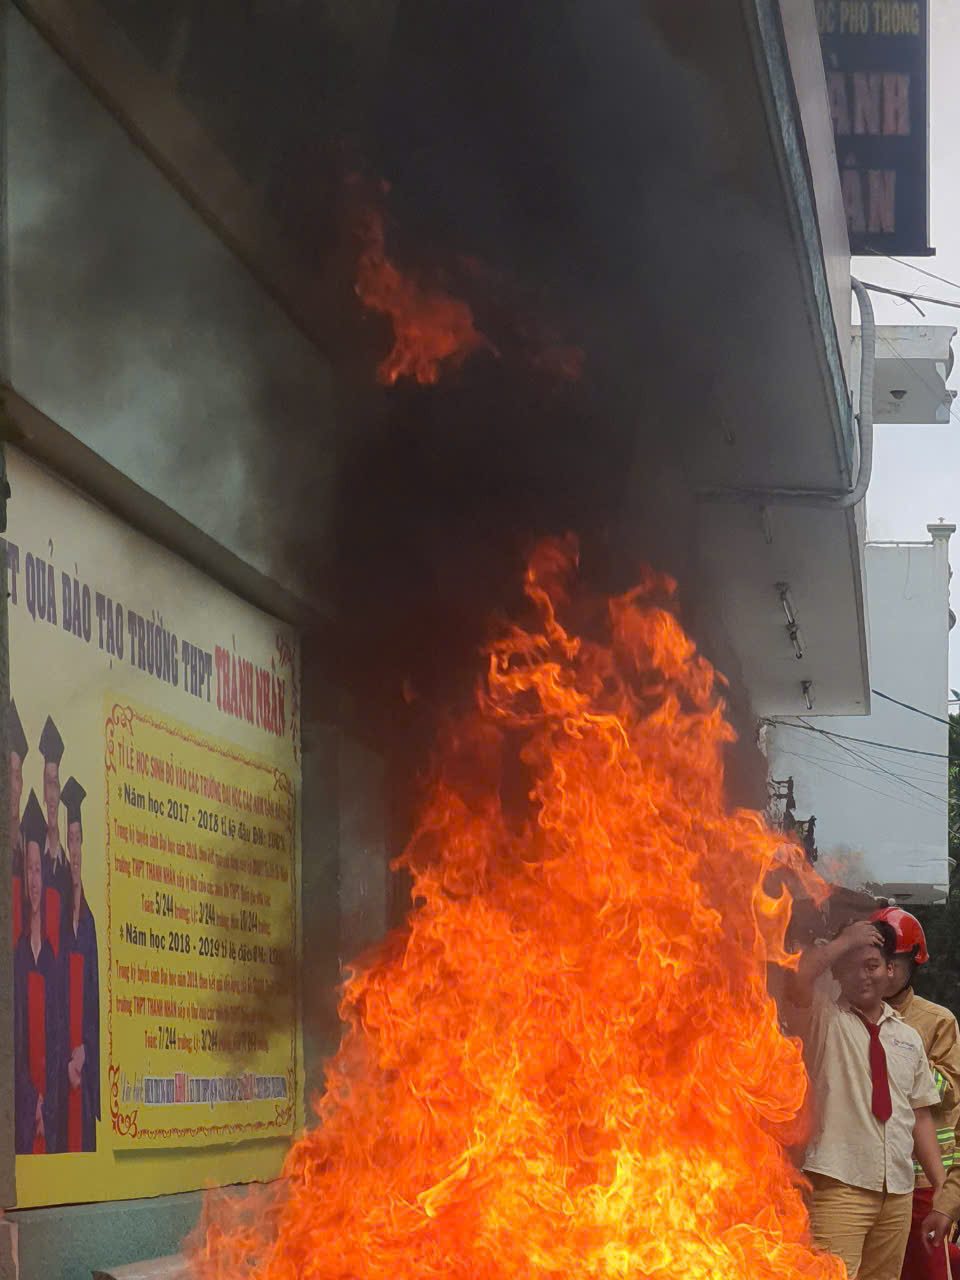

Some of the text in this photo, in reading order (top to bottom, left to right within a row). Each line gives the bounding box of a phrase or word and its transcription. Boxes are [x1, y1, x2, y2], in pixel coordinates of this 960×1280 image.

[25, 537, 58, 626] QUẢ
[61, 562, 92, 643] ĐÀO
[96, 591, 124, 669] TẠO
[128, 608, 179, 688] TRƯỜNG
[182, 640, 213, 703] THPT
[215, 633, 254, 726] THÀNH
[124, 782, 146, 810] Năm
[148, 792, 165, 819] học
[167, 799, 189, 824] 2017
[197, 808, 219, 833] 2018
[125, 921, 146, 946] Năm
[149, 928, 166, 953] học
[168, 931, 191, 954] 2018
[198, 936, 220, 958] 2019
